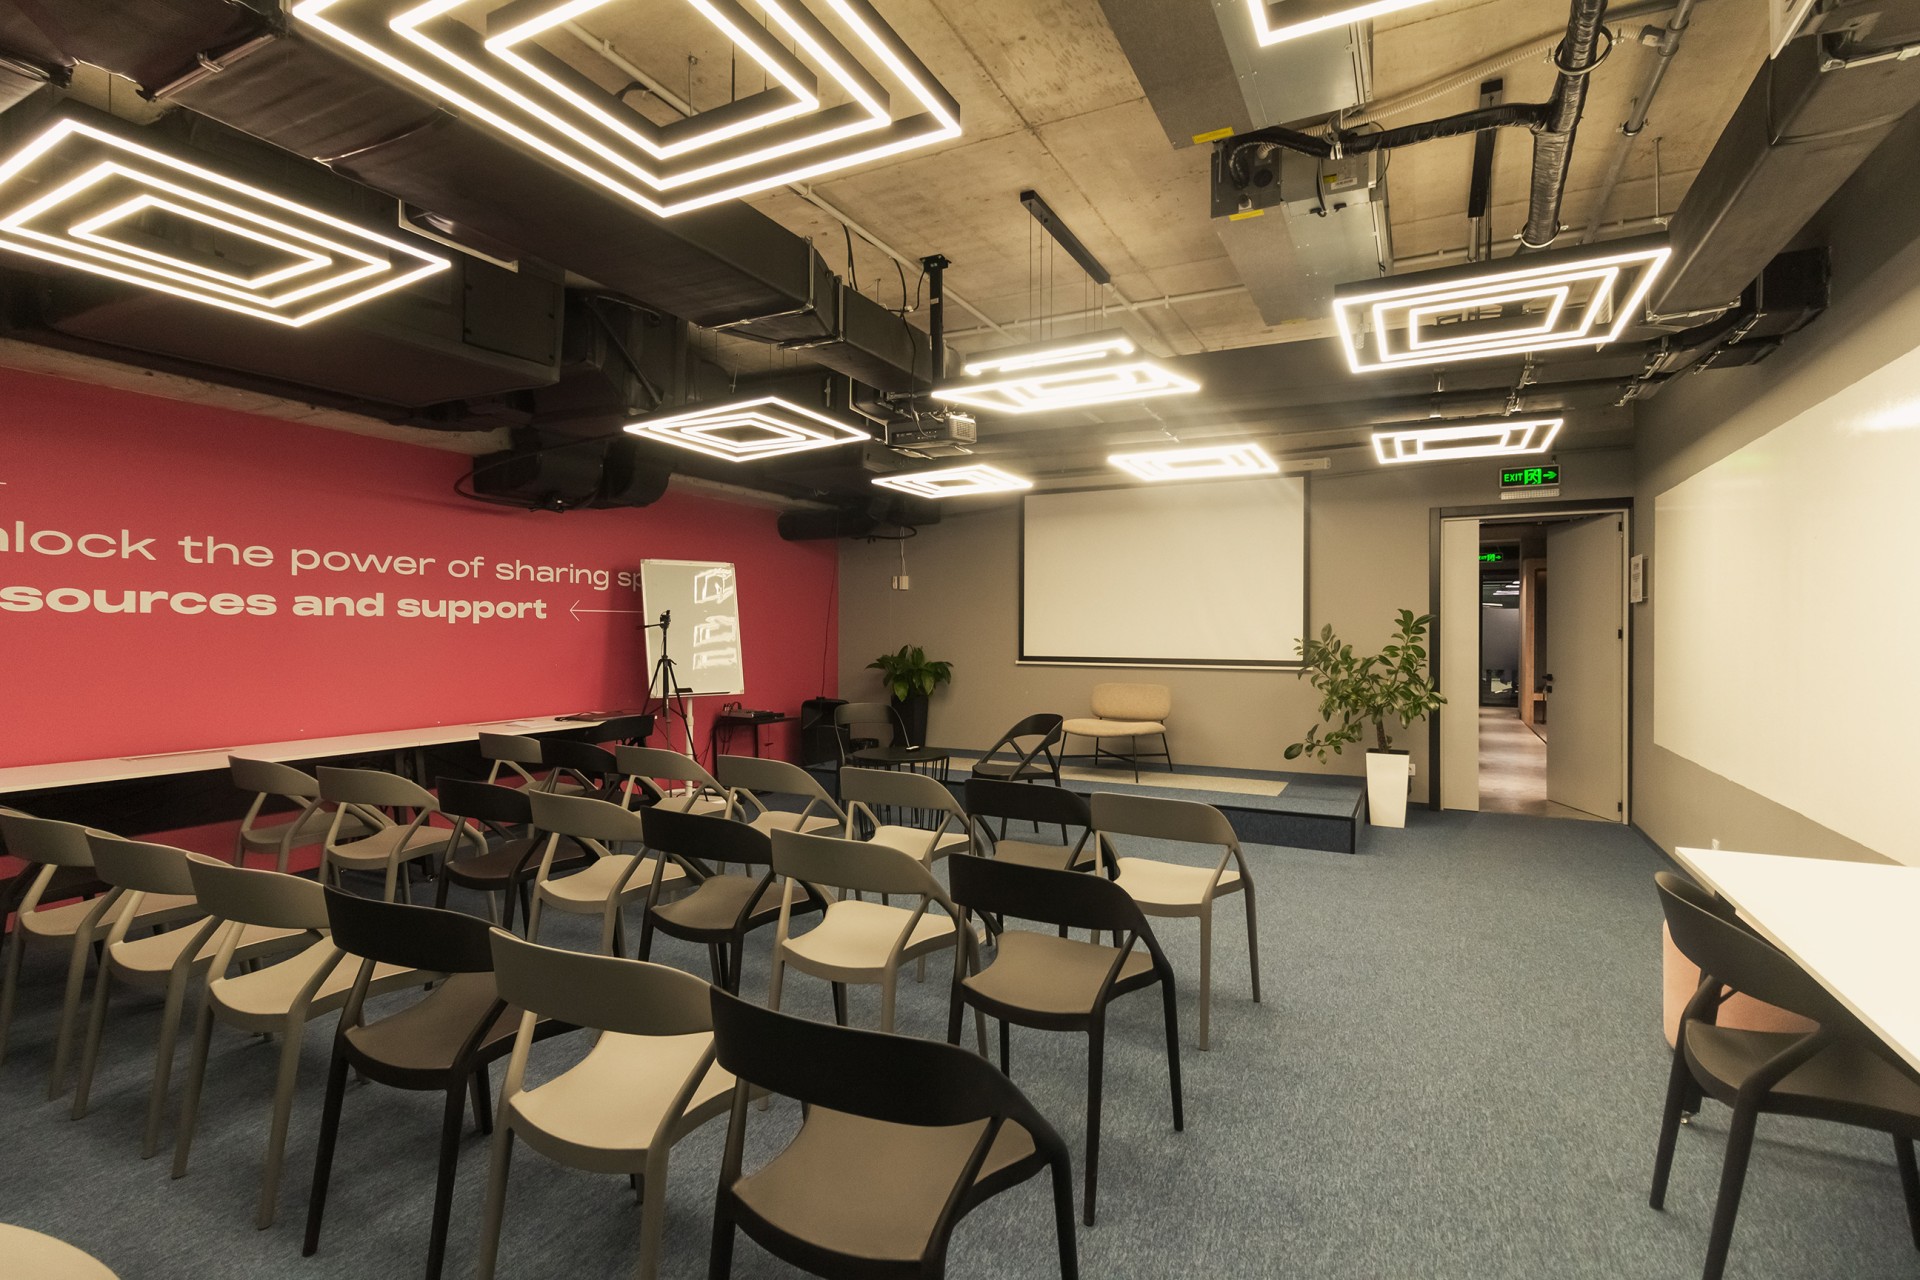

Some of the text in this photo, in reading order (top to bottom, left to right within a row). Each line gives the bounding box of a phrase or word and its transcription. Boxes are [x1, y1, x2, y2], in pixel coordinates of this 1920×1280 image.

[1503, 472, 1523, 482] EXIT
[0, 520, 157, 561] lock
[177, 535, 274, 568] the
[291, 548, 436, 577] power
[447, 556, 485, 579] of
[495, 560, 610, 591] sharing
[291, 593, 385, 618] and
[396, 598, 548, 625] support
